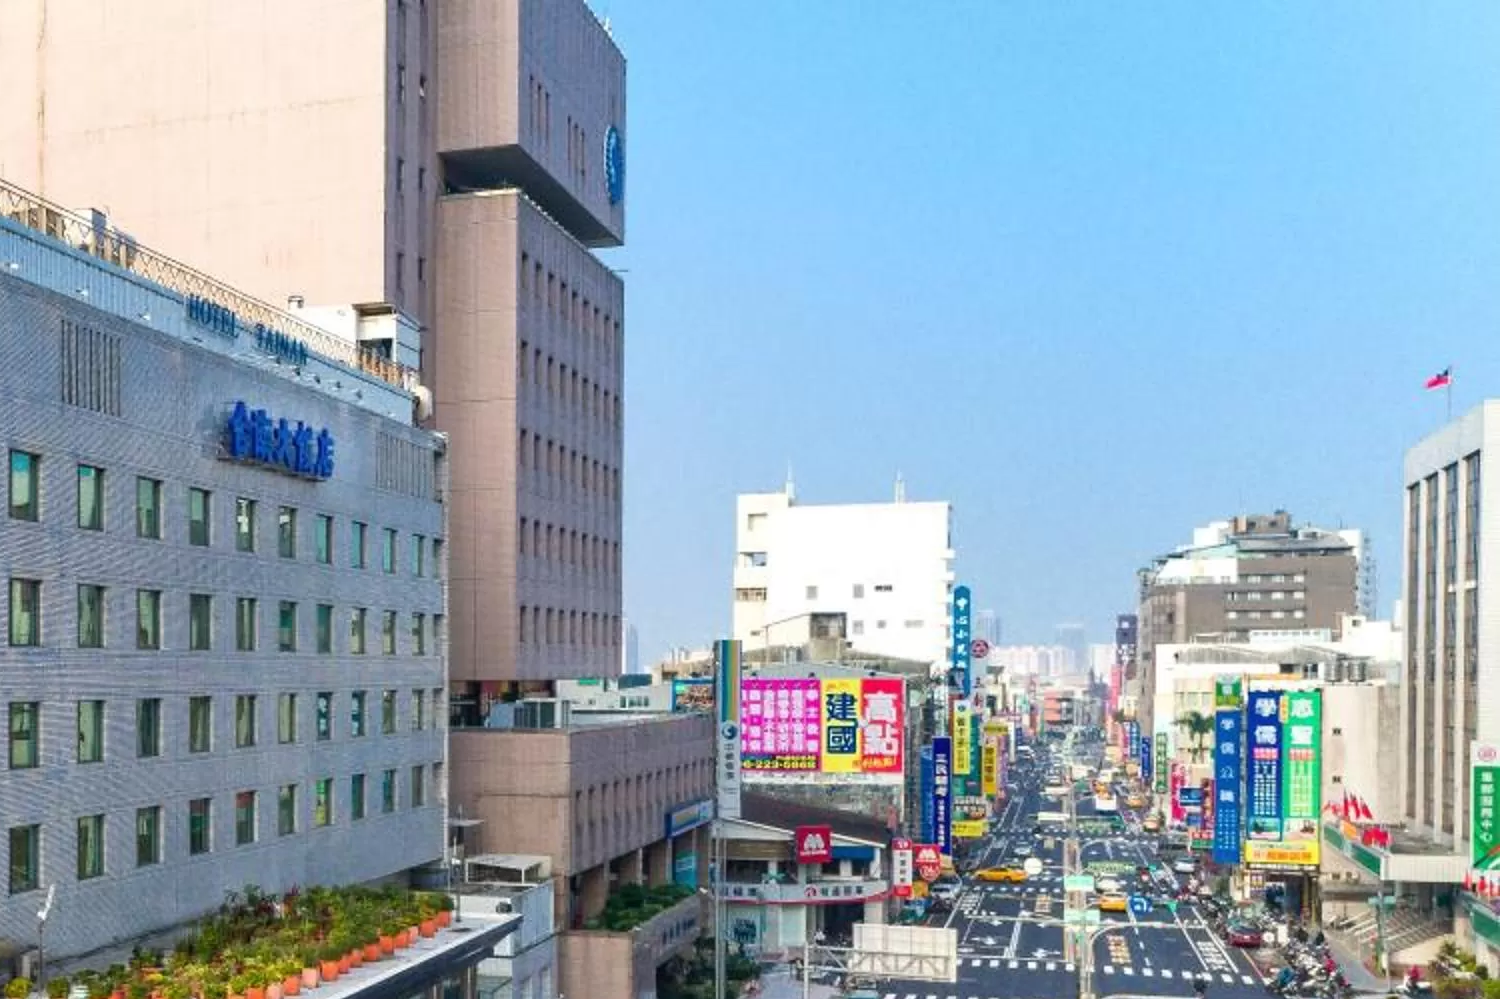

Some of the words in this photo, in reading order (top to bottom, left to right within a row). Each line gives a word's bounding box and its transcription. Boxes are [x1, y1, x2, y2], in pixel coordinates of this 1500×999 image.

[187, 293, 239, 339] HOTEL
[255, 323, 308, 366] TAINAN
[825, 692, 858, 754] 建國
[862, 690, 899, 756] 高點
